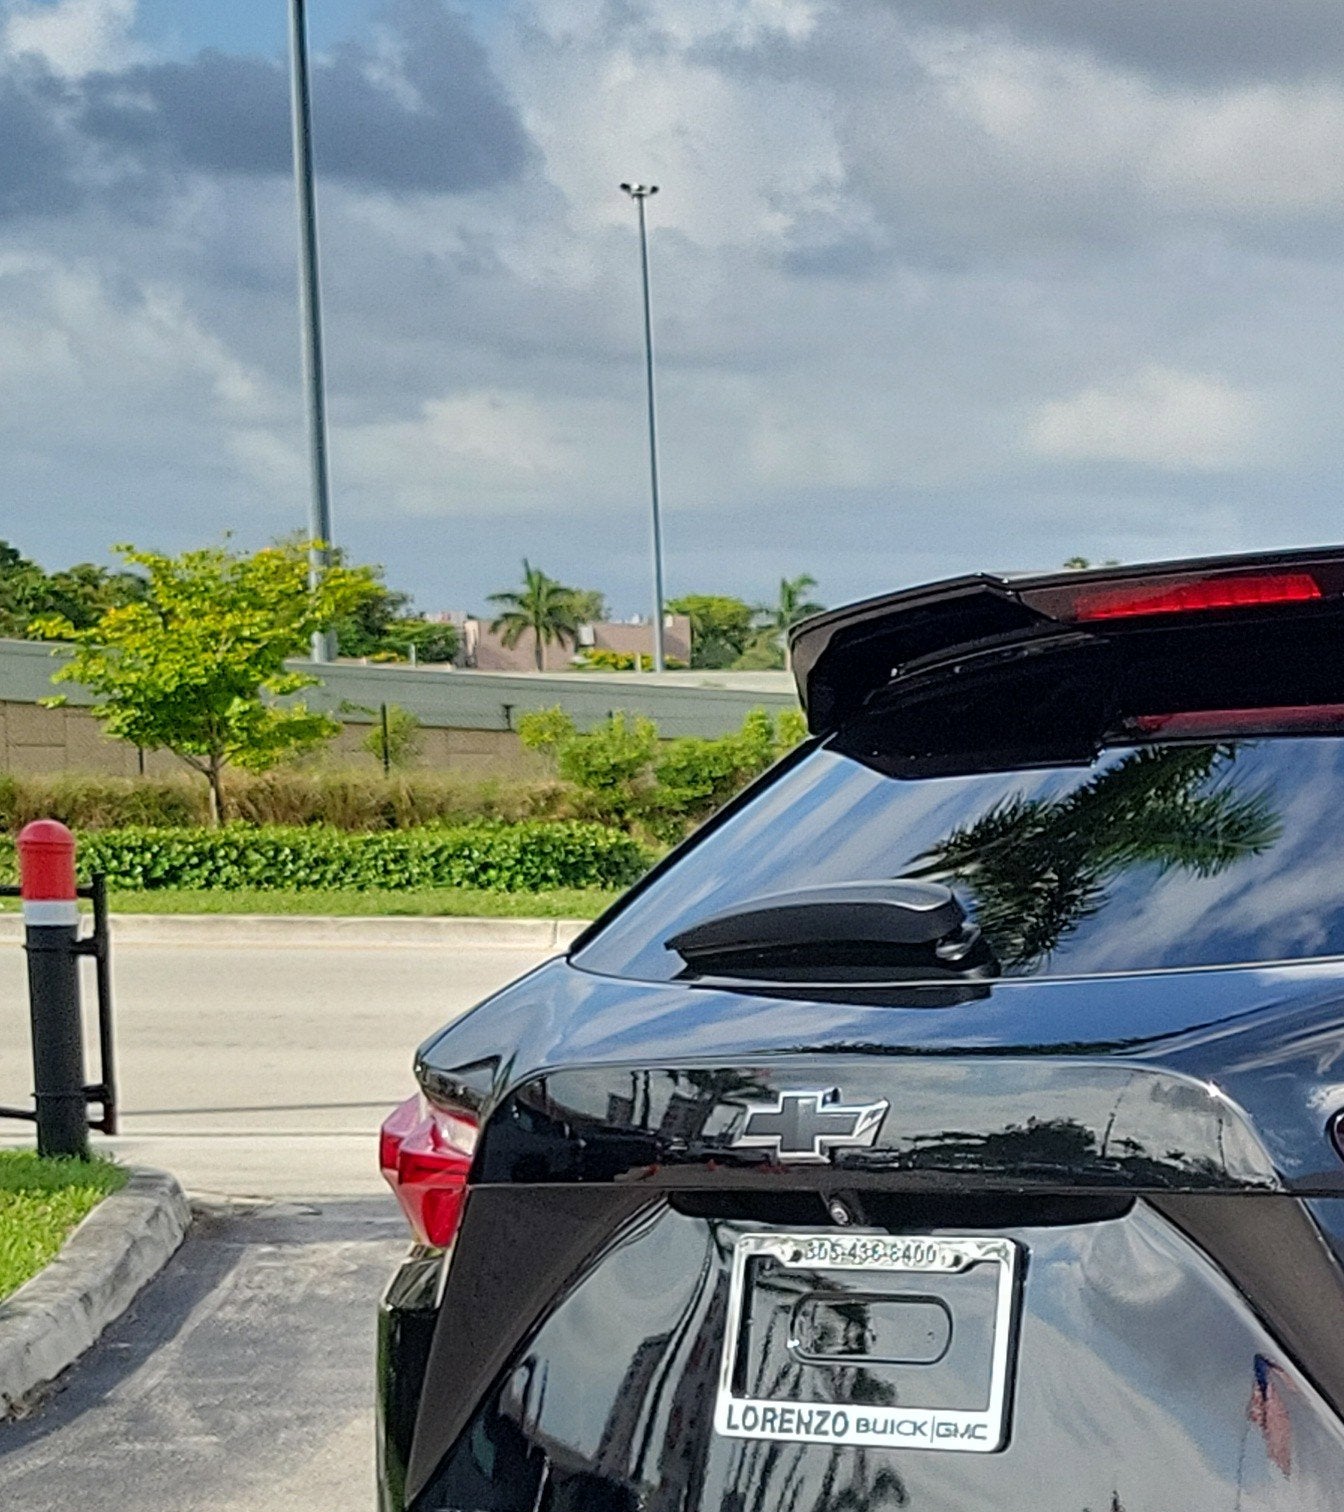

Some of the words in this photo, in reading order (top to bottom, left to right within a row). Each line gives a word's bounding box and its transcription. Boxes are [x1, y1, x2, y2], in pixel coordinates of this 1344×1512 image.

[726, 1404, 849, 1437] LORENZO
[855, 1417, 928, 1437] BUICK
[935, 1421, 988, 1441] GMC
